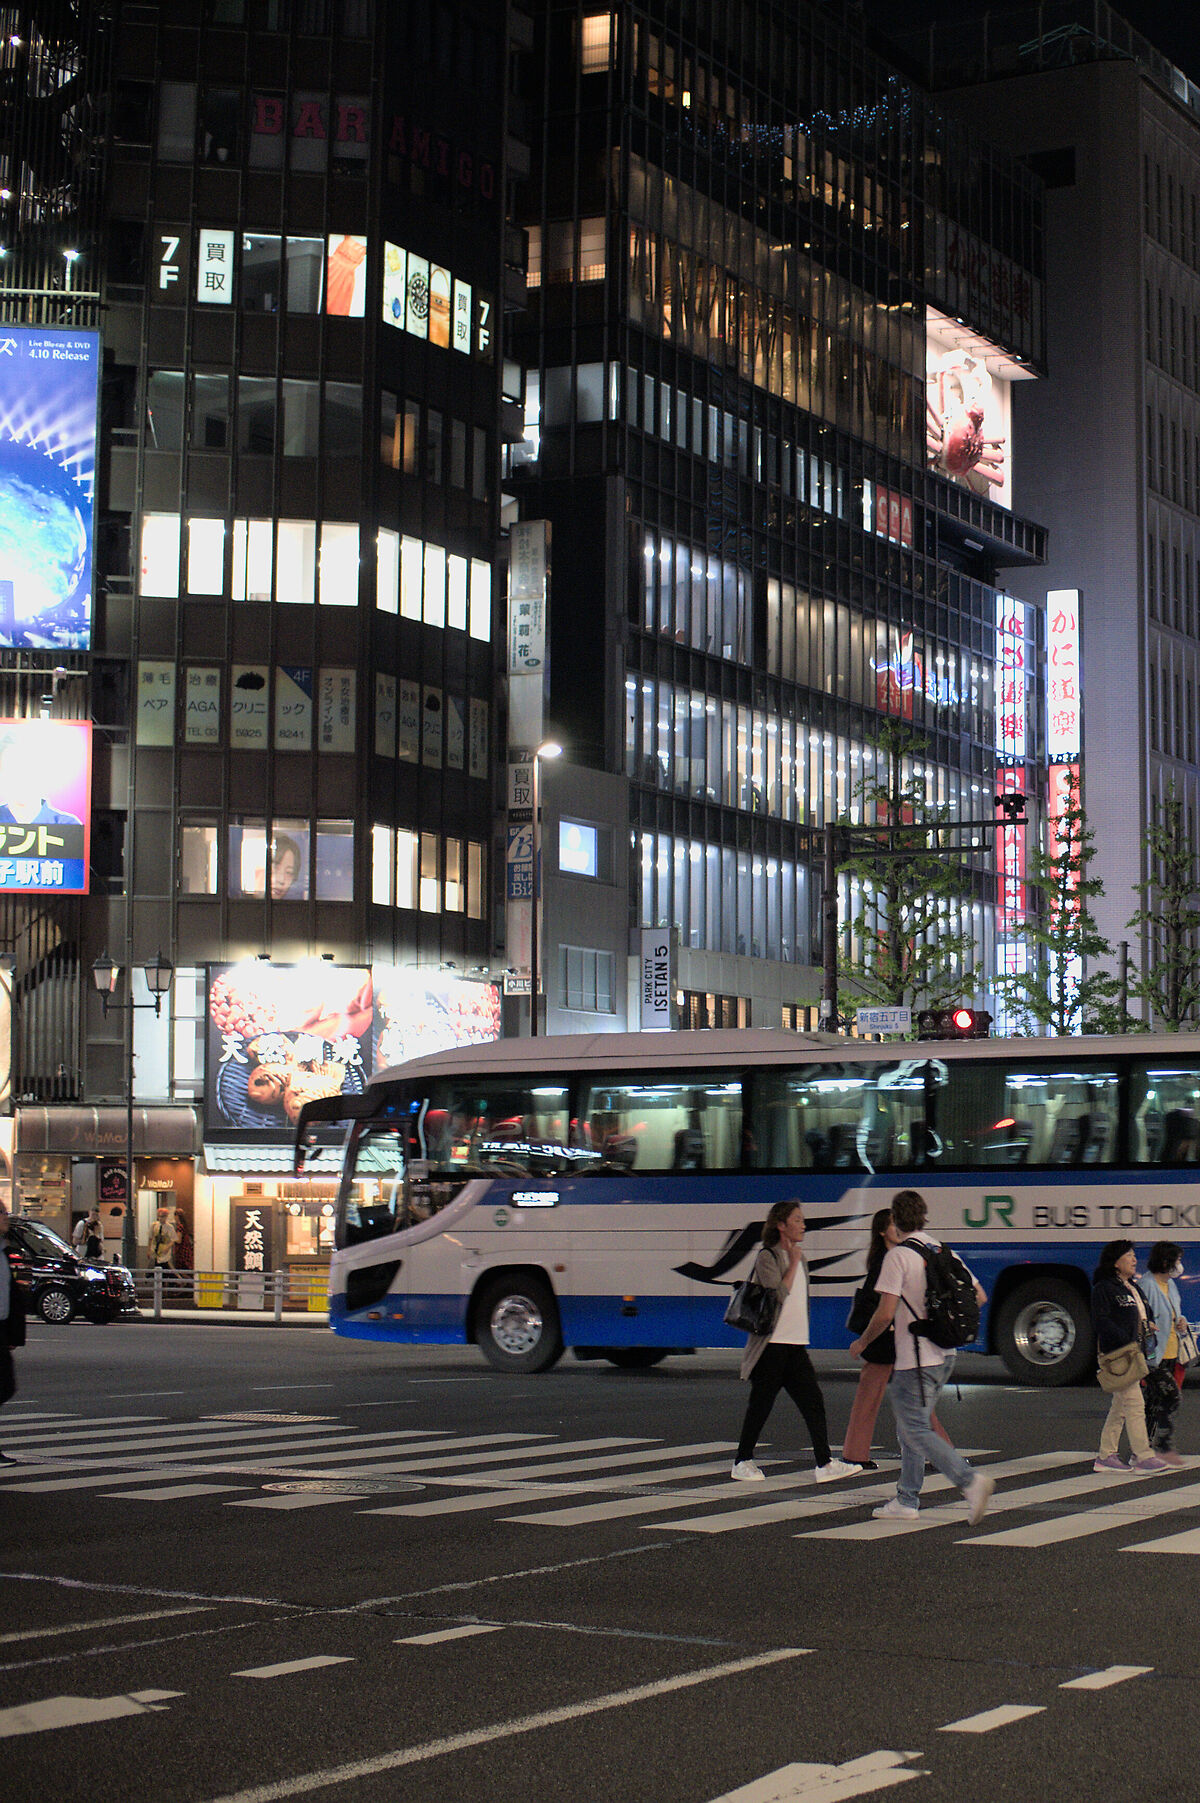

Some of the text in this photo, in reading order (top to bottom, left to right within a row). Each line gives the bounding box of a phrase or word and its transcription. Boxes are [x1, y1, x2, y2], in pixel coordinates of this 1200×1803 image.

[254, 98, 496, 200] BAR AMIGO
[205, 242, 226, 291] 買取
[457, 293, 470, 343] 買取
[29, 349, 90, 361] 4.10 Release
[293, 670, 310, 681] 4F
[1051, 609, 1076, 737] かに道楽
[188, 700, 218, 713] AGA
[514, 768, 530, 805] 買取
[0, 825, 64, 857] ント
[0, 859, 64, 885] 子駅前
[644, 958, 653, 1004] PARK CITY
[654, 945, 668, 1012] ISETAN 5
[860, 1010, 908, 1023] 新宿五丁目
[965, 1194, 1015, 1228] JR
[1033, 1204, 1090, 1227] BUS
[243, 1209, 265, 1272] 天然鯛
